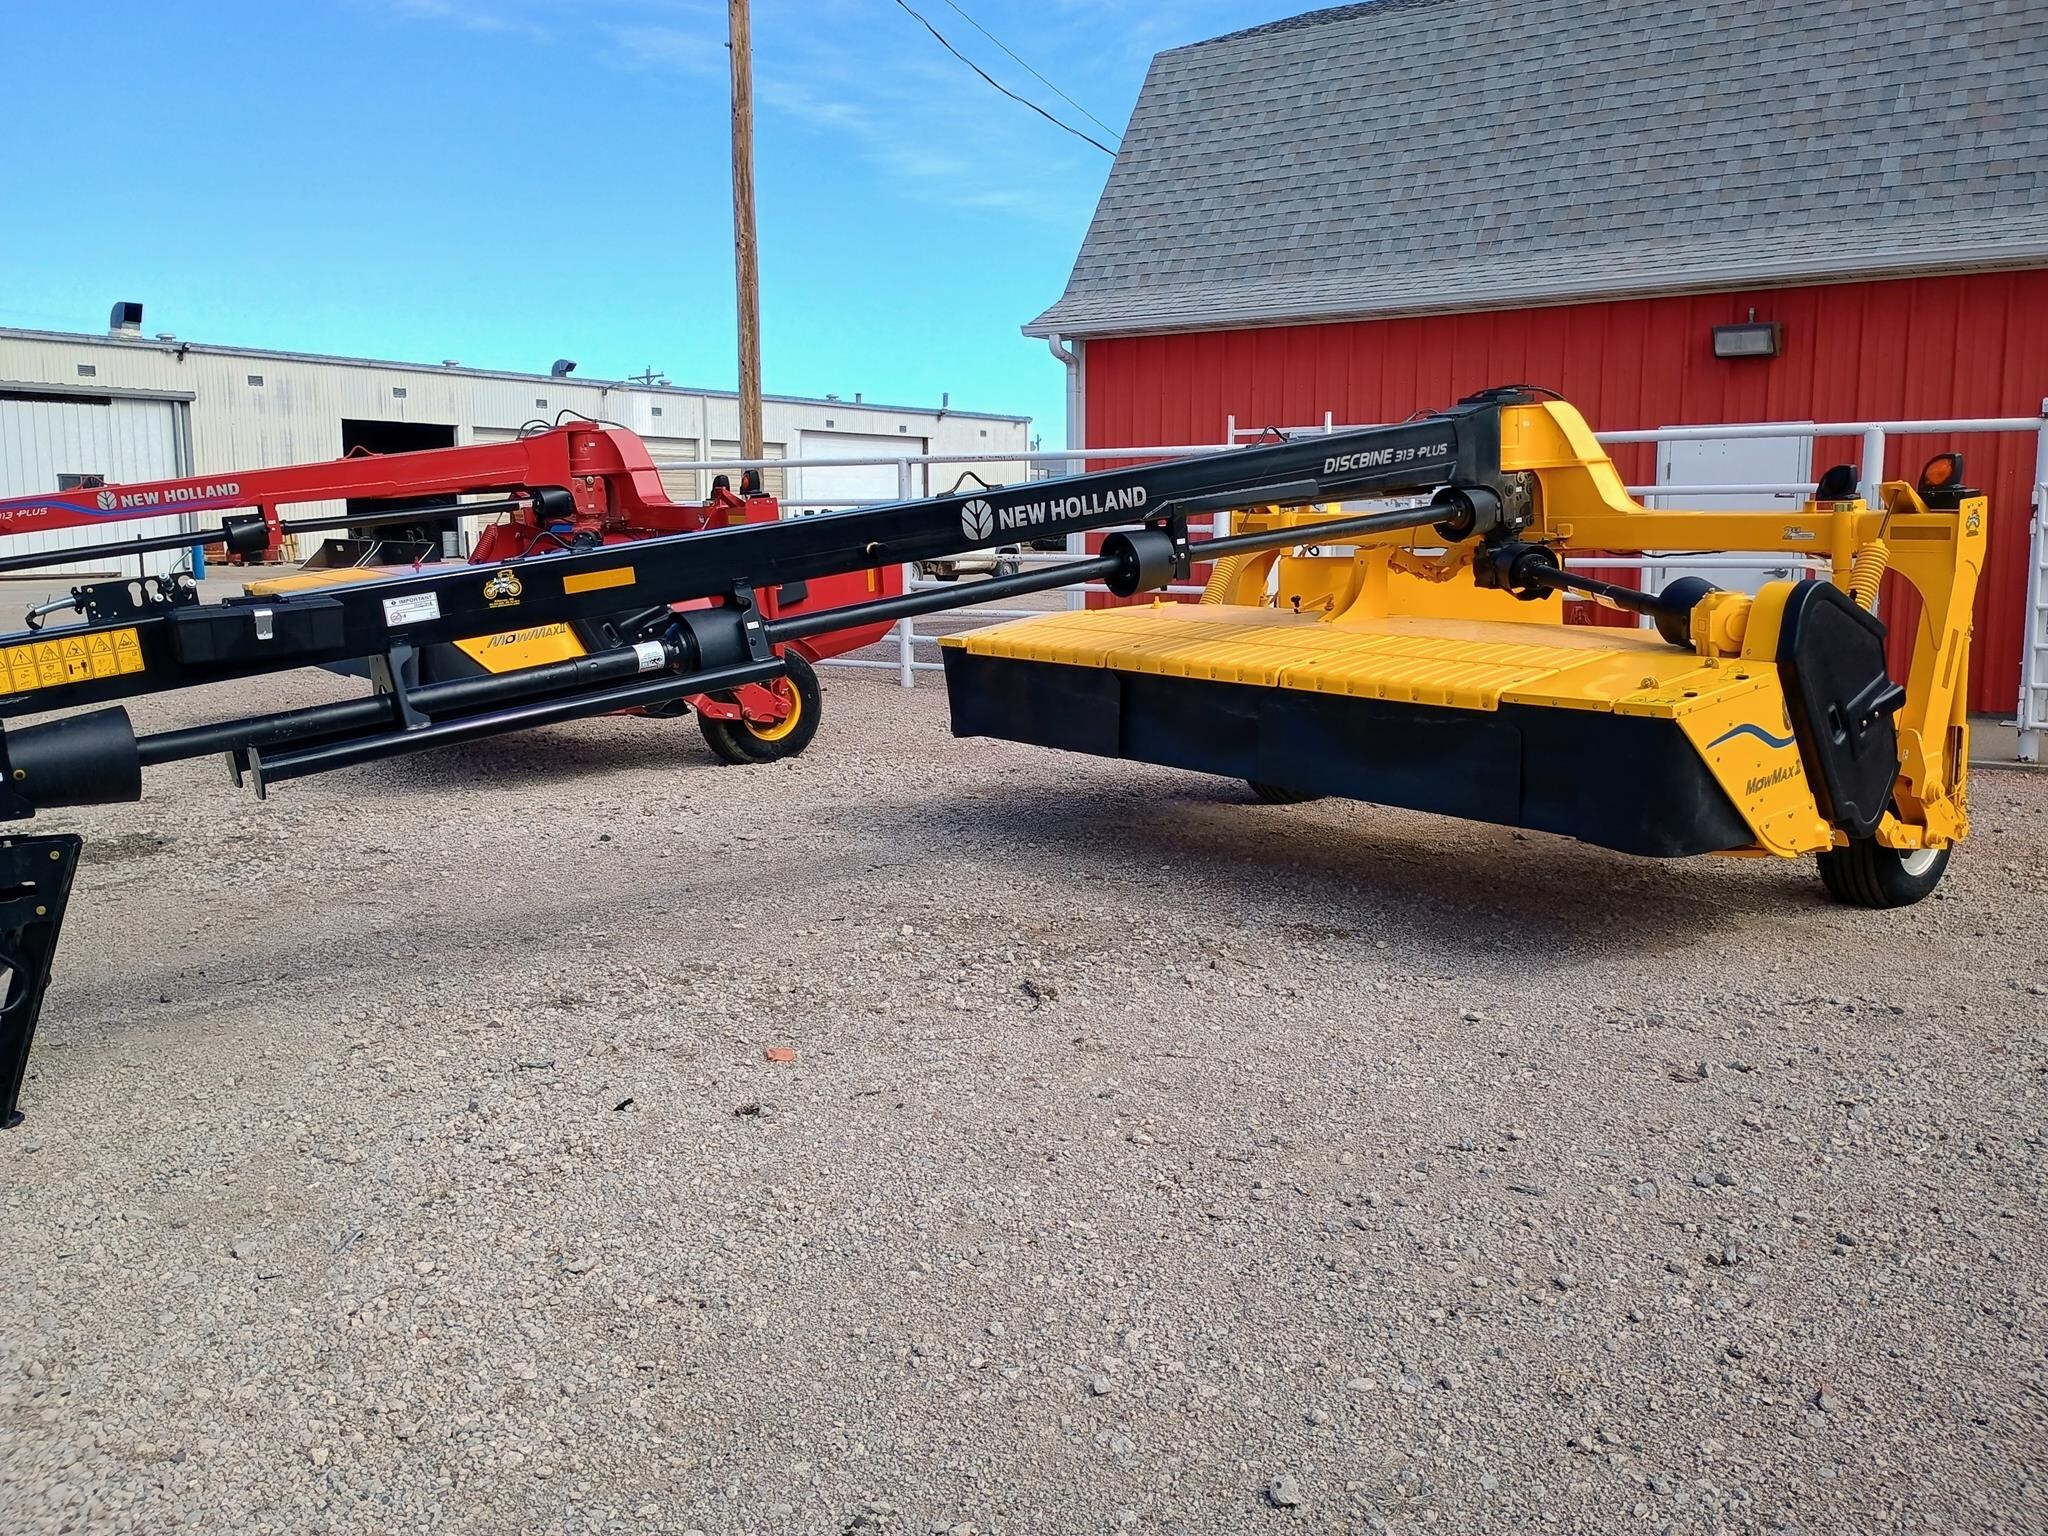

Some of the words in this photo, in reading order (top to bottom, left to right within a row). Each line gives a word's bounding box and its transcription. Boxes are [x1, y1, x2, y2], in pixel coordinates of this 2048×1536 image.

[1323, 448, 1394, 474] DISCBINE
[1394, 448, 1415, 462] 313
[120, 491, 159, 508] NEW
[163, 482, 240, 503] HOLLAND
[998, 502, 1046, 530] NEW
[1049, 486, 1147, 521] HOLLAND
[398, 594, 432, 604] IMPORTANT
